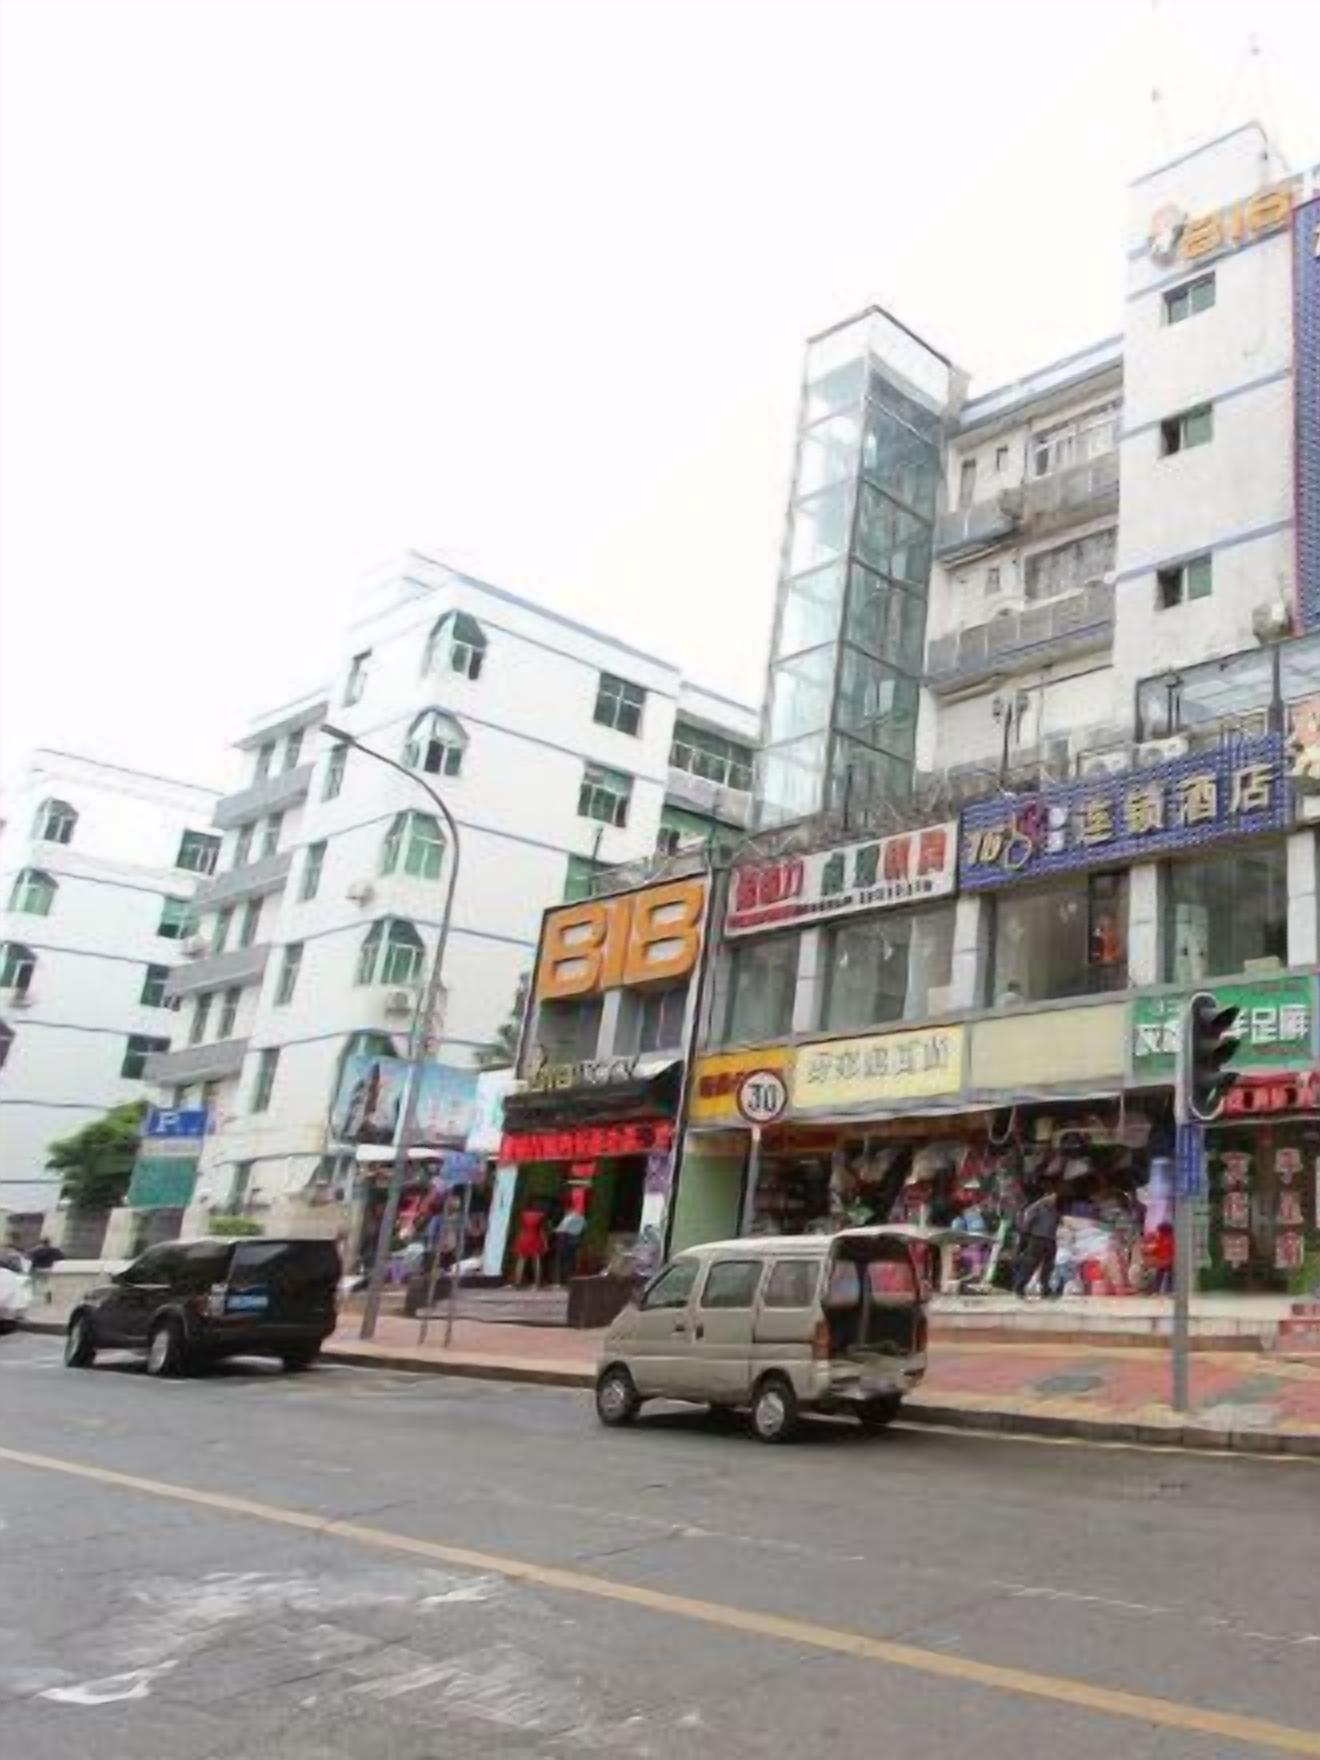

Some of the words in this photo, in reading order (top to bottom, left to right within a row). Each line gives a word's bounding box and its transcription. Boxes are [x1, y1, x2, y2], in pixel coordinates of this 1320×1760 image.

[1075, 762, 1276, 847] 连锁酒店
[537, 880, 705, 1001] 818
[746, 1082, 778, 1112] 30
